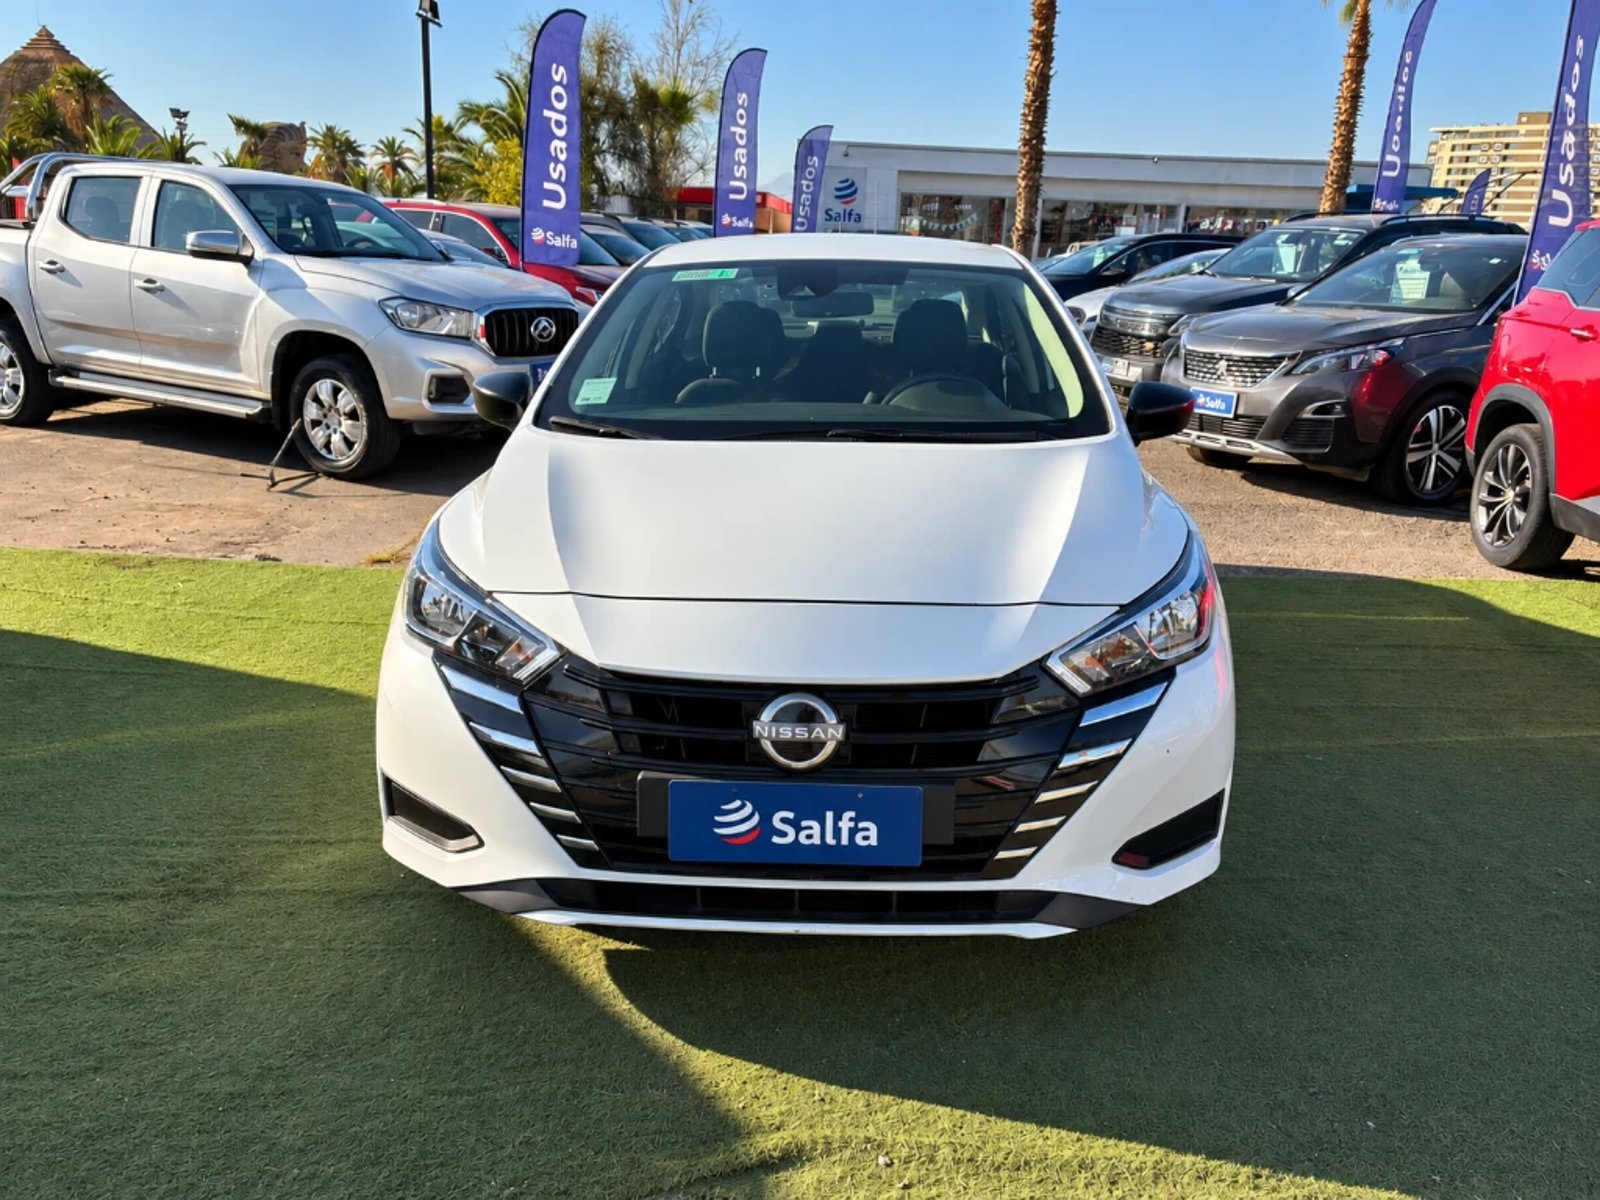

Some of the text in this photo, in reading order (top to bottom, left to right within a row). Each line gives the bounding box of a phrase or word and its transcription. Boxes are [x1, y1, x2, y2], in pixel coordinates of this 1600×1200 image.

[542, 63, 568, 210] Usados
[729, 92, 748, 200] Usados
[1548, 34, 1584, 228] Usados
[795, 155, 818, 231] Usados
[824, 208, 862, 223] Salfa
[546, 231, 578, 249] Salfa
[755, 725, 843, 739] NISSAN
[771, 810, 878, 846] Salfa
